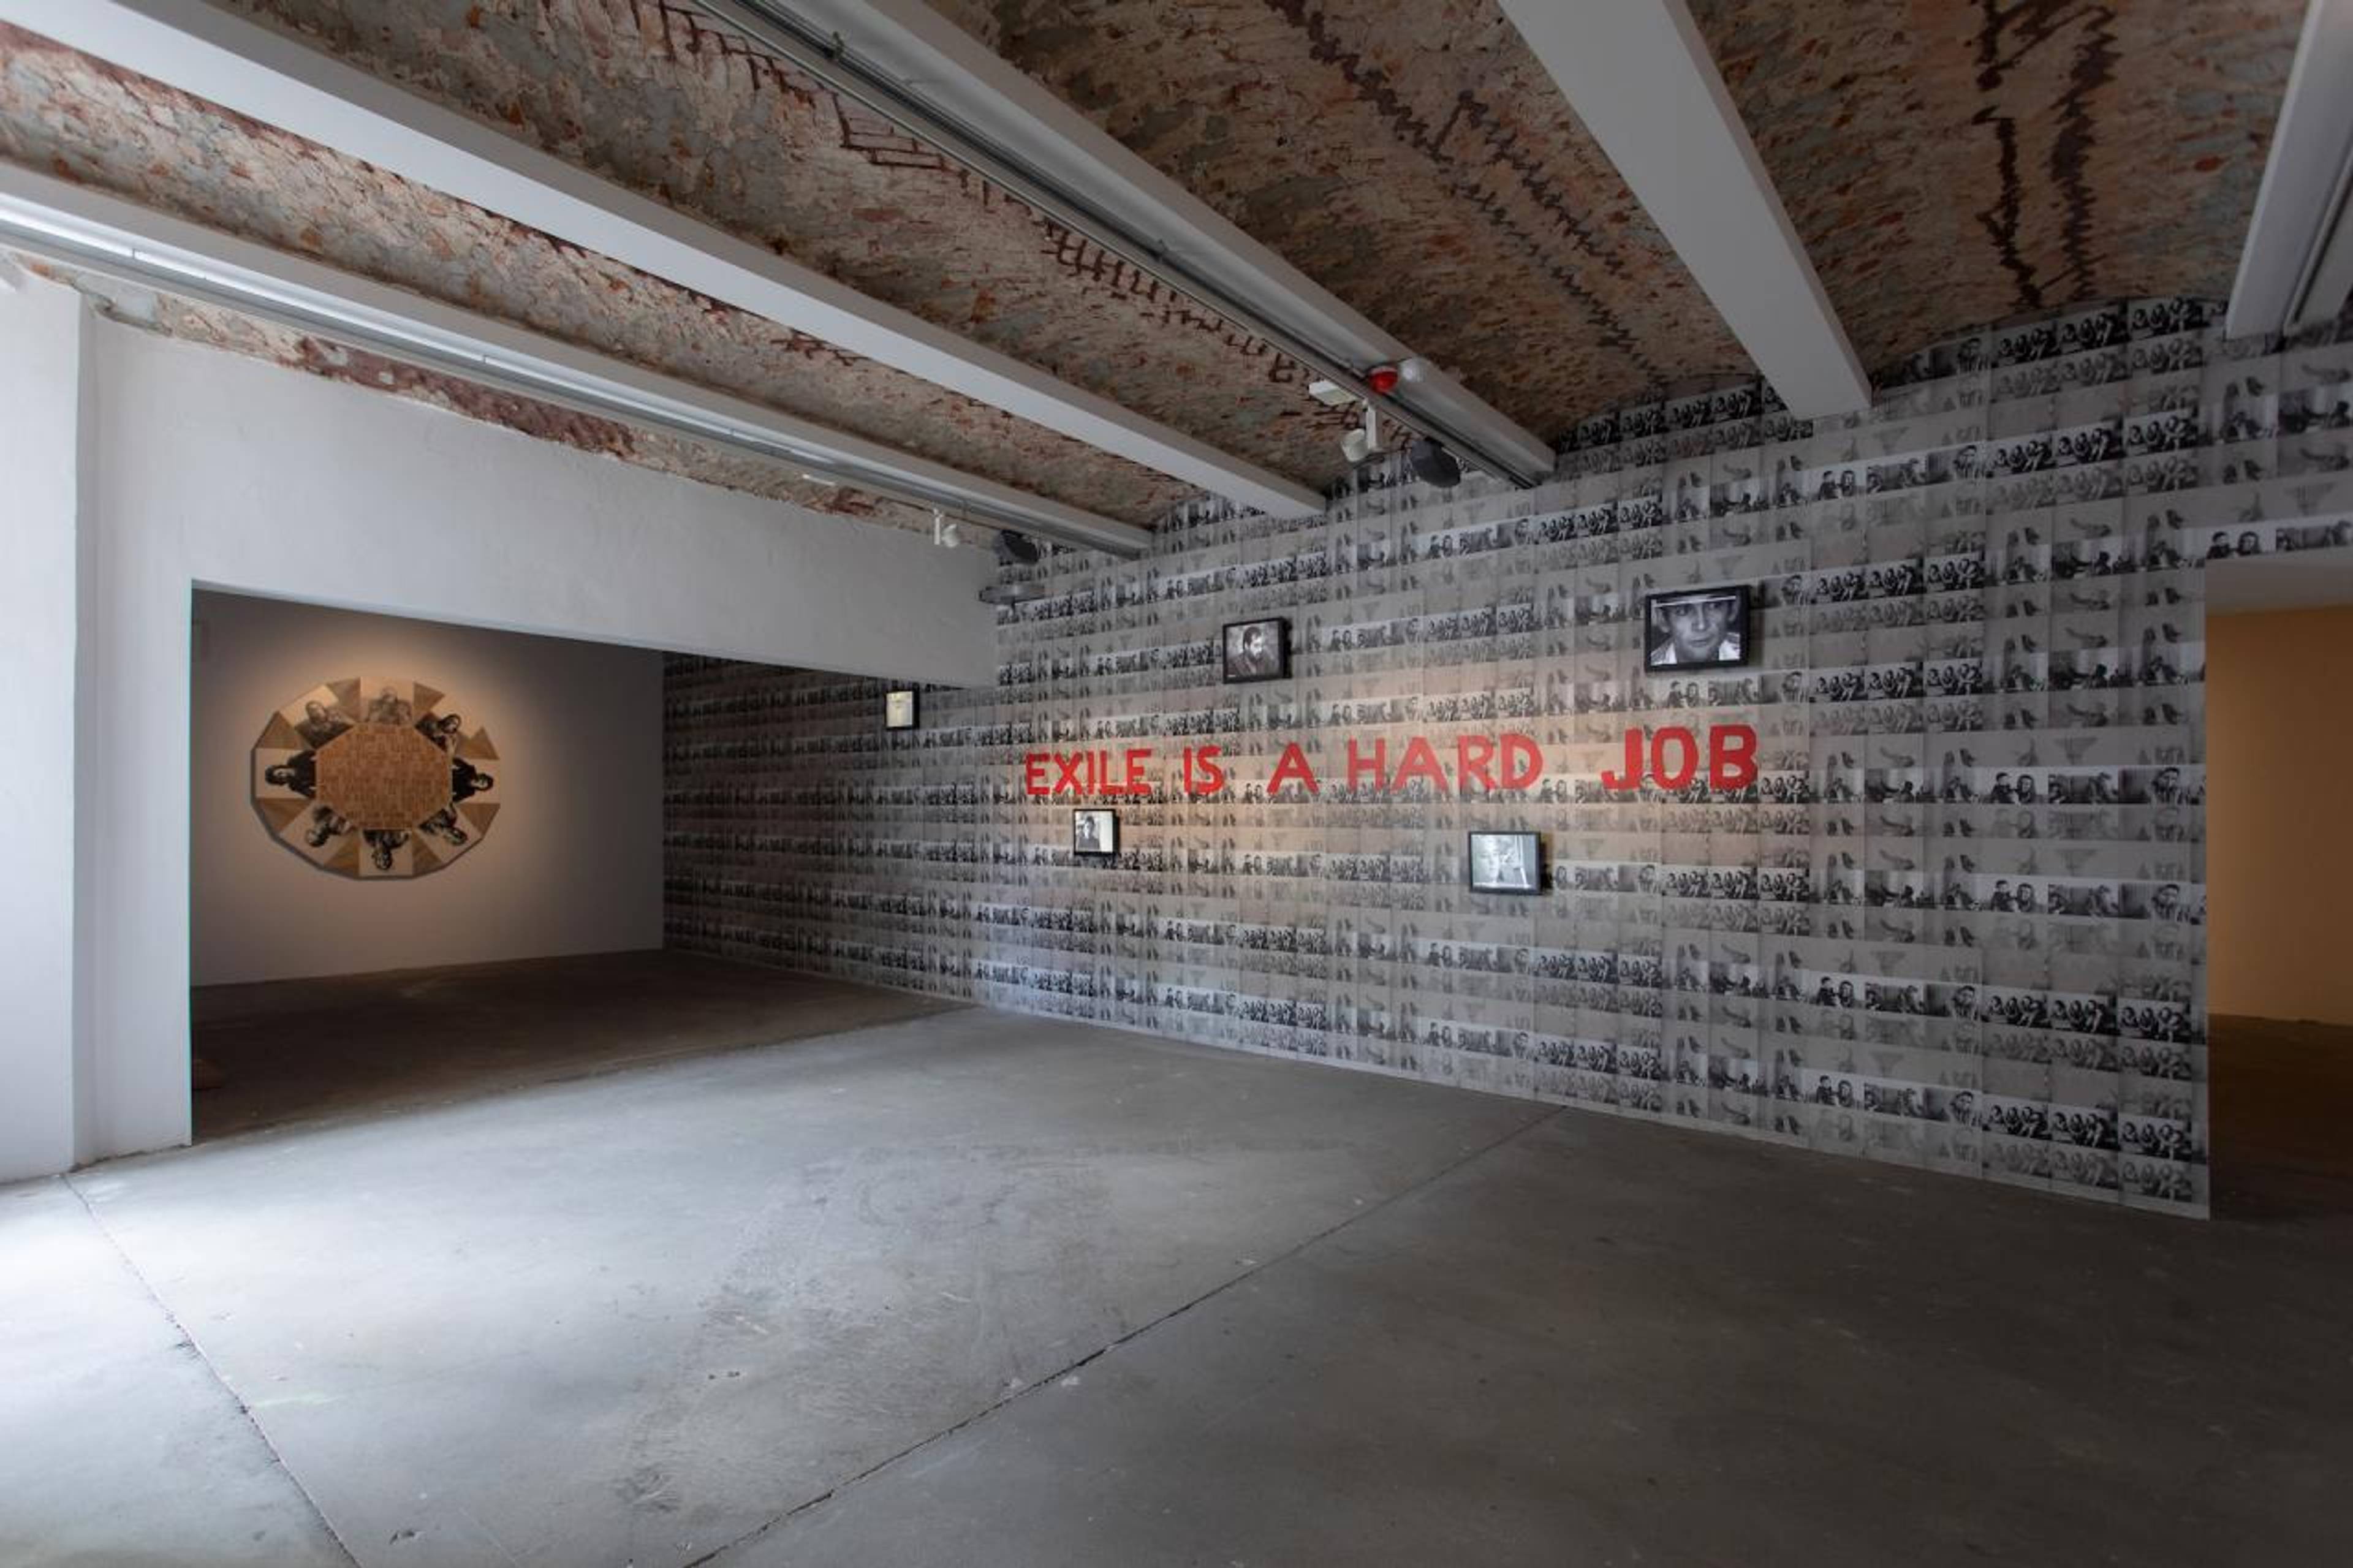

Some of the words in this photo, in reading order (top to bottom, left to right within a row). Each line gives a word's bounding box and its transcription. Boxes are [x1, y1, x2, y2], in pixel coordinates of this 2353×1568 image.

[1025, 746, 1153, 797] EXILE
[1183, 744, 1226, 796] IS
[1267, 741, 1319, 795] A
[1347, 733, 1545, 790] HARD
[1599, 724, 1759, 791] JOB
